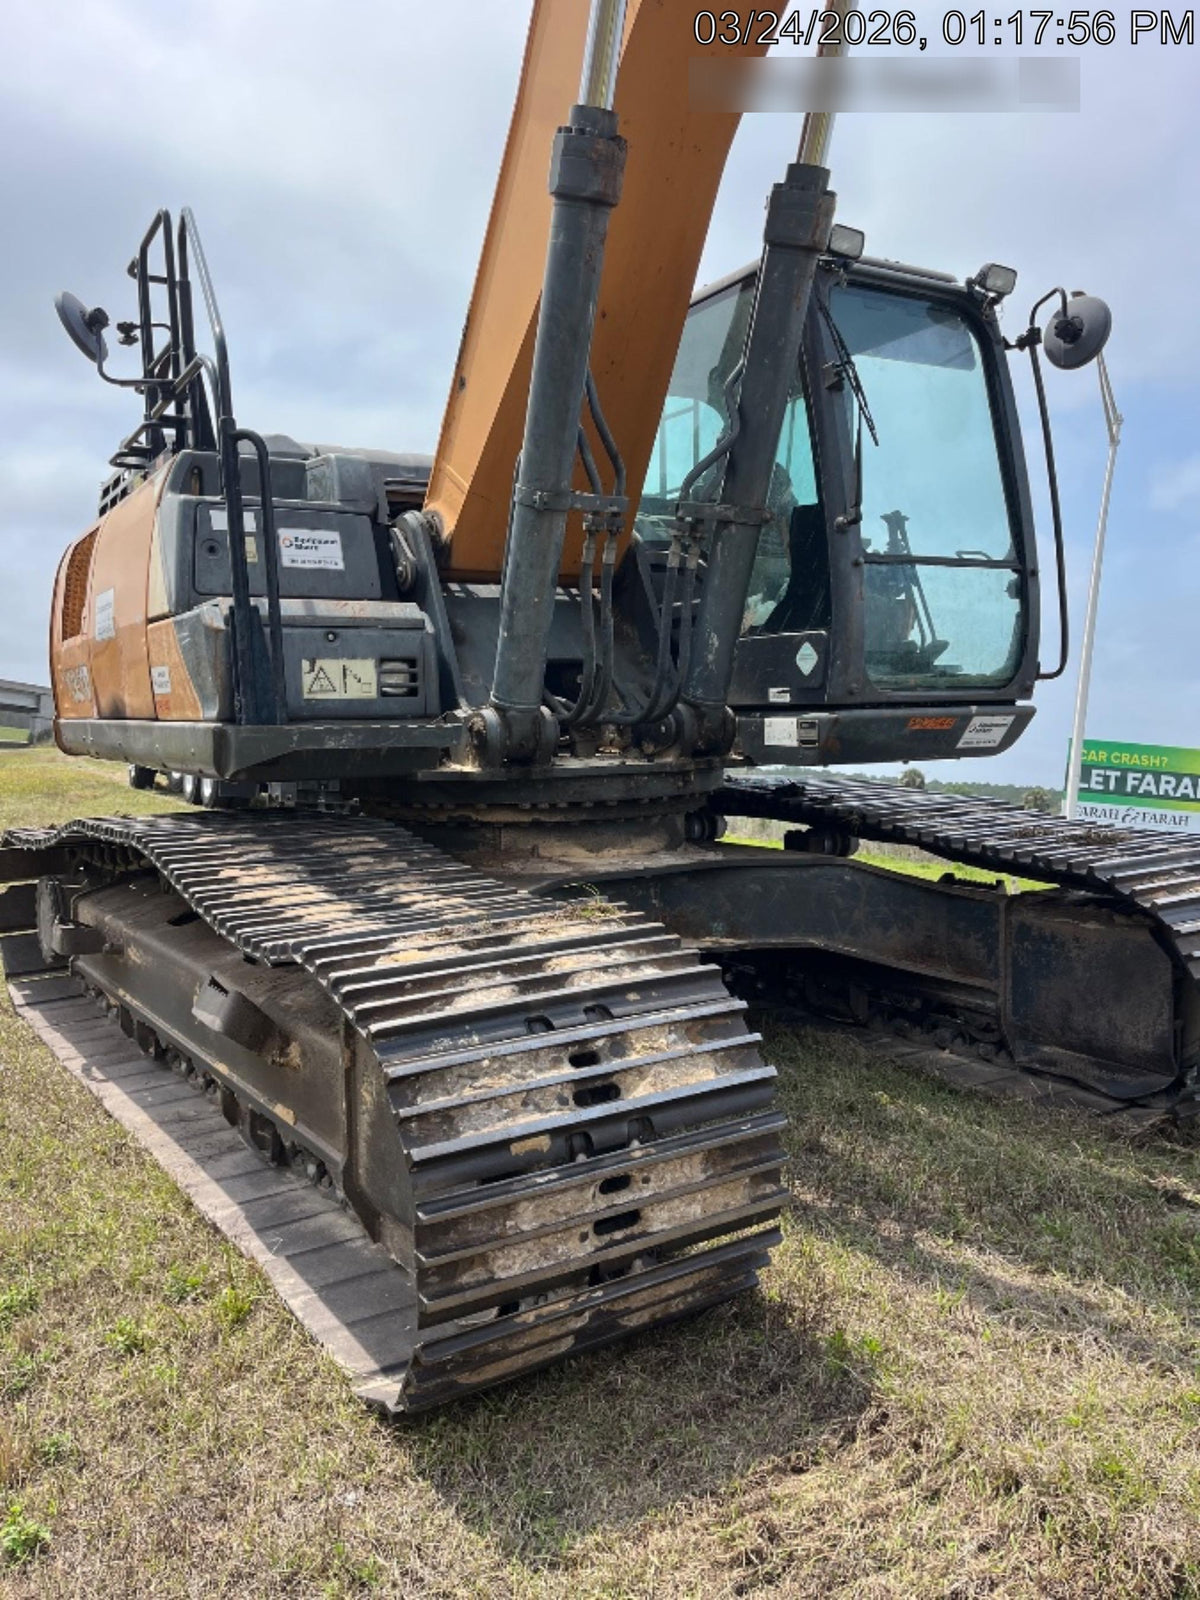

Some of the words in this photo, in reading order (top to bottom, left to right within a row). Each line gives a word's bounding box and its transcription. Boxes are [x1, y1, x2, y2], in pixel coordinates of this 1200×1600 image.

[1080, 749, 1107, 762] CAR
[1110, 751, 1168, 767] CRASH?
[1142, 811, 1192, 827] FARAH
